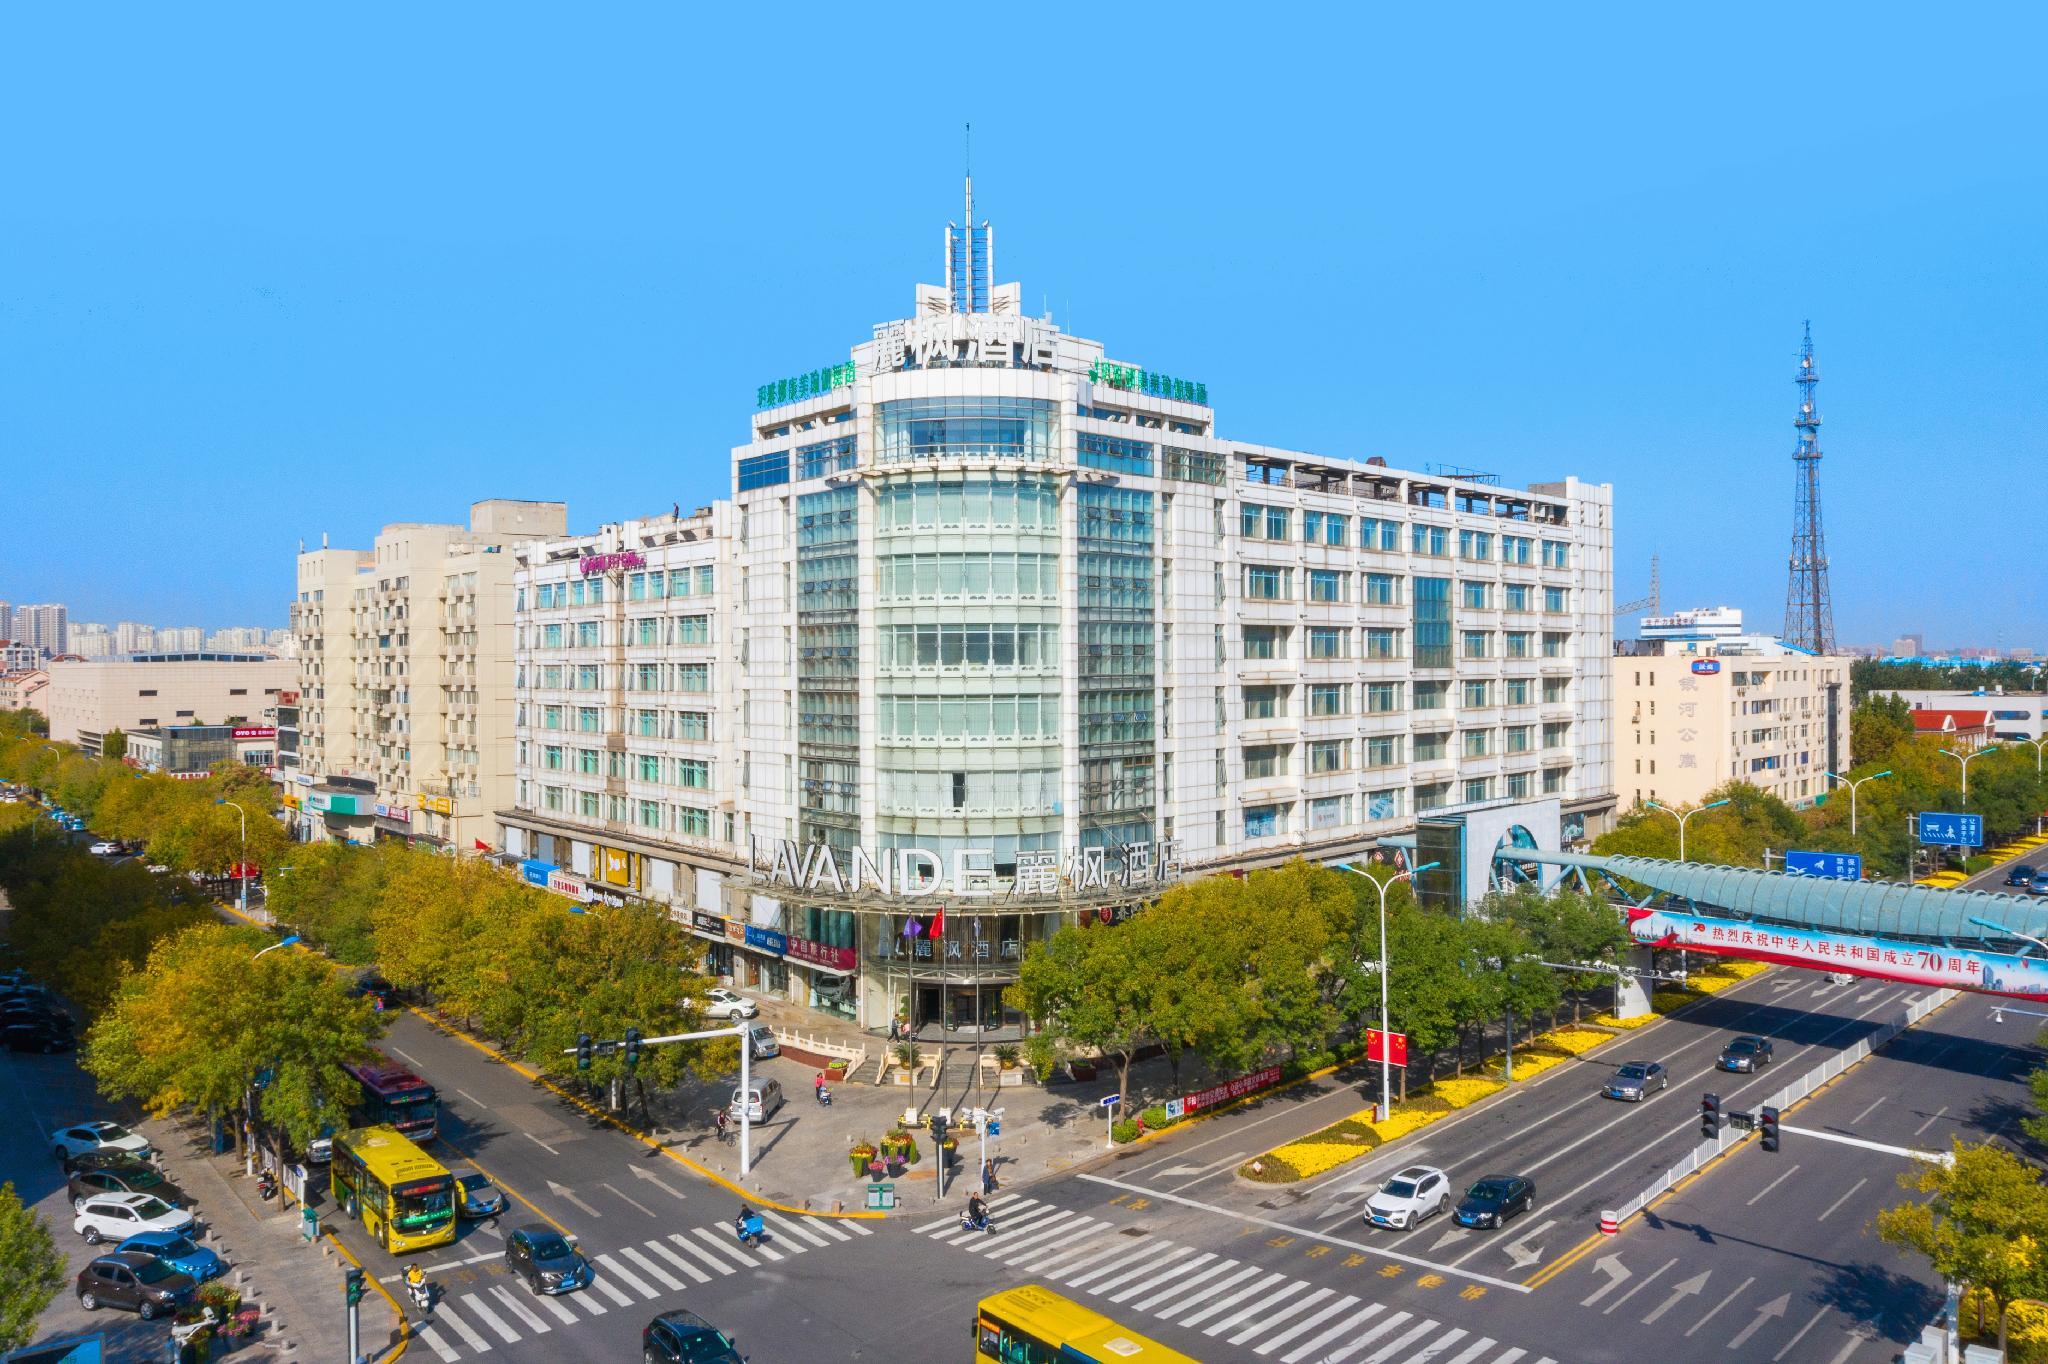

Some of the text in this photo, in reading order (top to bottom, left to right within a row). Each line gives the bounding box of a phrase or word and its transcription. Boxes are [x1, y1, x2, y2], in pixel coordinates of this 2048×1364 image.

[748, 832, 994, 896] LAVANDE
[1712, 926, 1981, 975] 热烈庆祝中华人民共和国成立70周年
